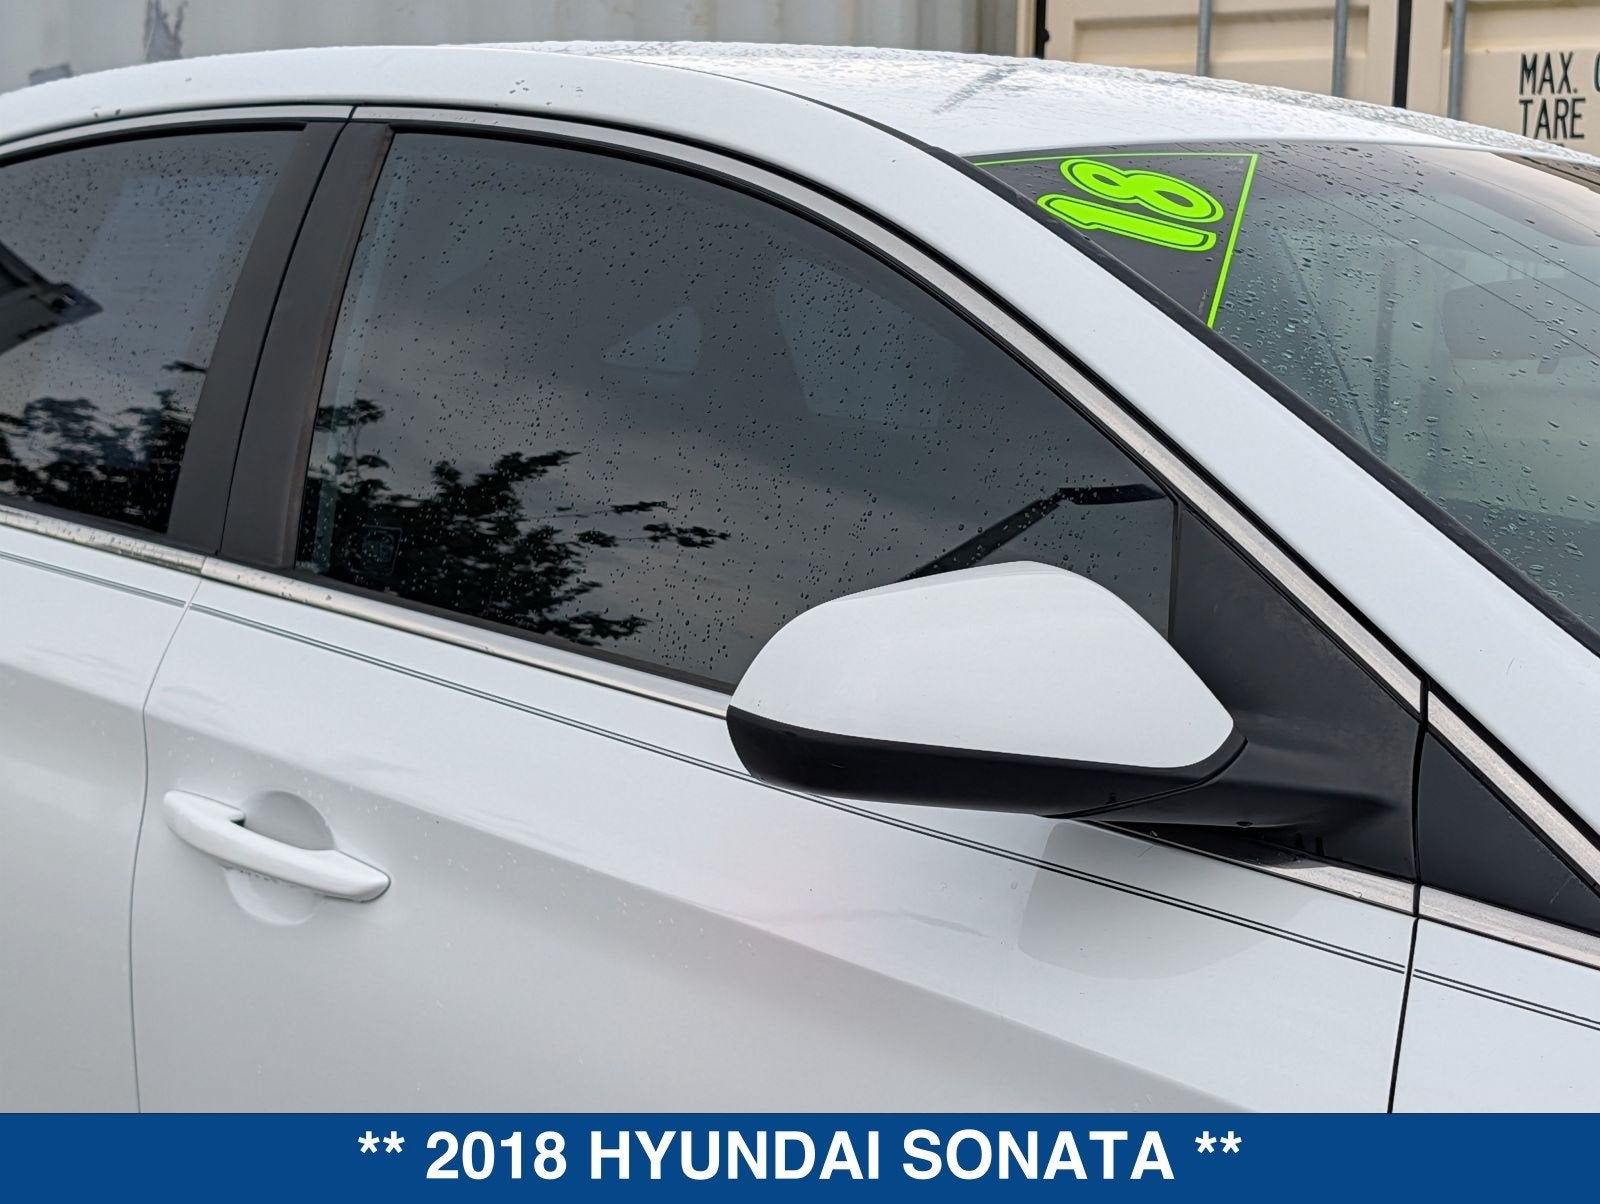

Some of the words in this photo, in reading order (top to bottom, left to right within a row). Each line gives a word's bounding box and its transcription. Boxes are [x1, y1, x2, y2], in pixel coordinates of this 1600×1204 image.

[1519, 51, 1579, 95] MAX.
[1518, 97, 1587, 140] TARE
[1036, 158, 1224, 252] 18
